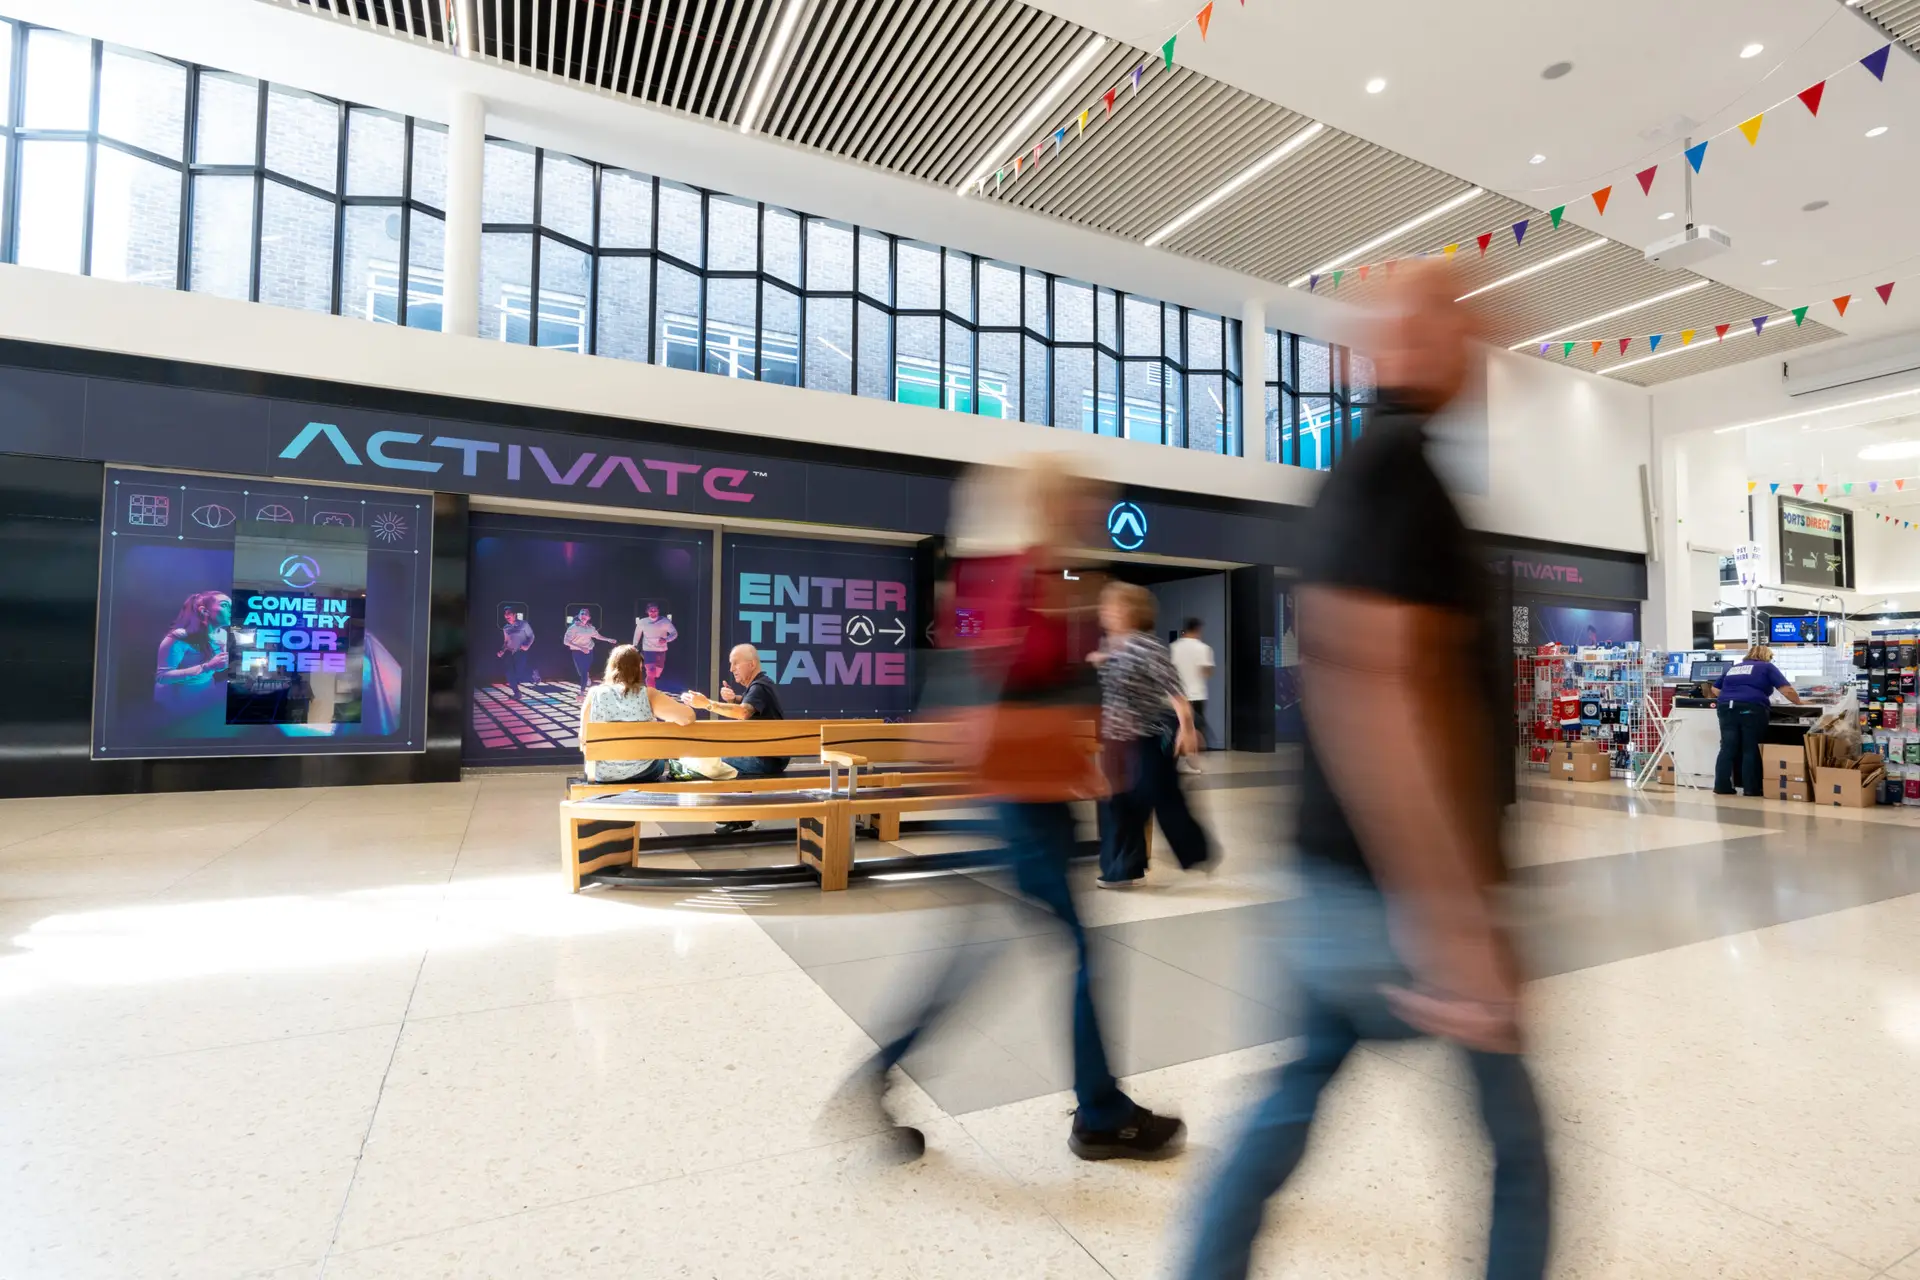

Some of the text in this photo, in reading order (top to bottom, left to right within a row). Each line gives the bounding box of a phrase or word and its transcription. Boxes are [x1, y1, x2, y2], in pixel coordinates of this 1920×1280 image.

[739, 572, 907, 612] ENTER
[247, 596, 347, 613] COME IN
[243, 612, 351, 629] AND TRY
[738, 610, 842, 645] THE
[256, 629, 338, 651] FOR
[241, 651, 347, 673] FREE
